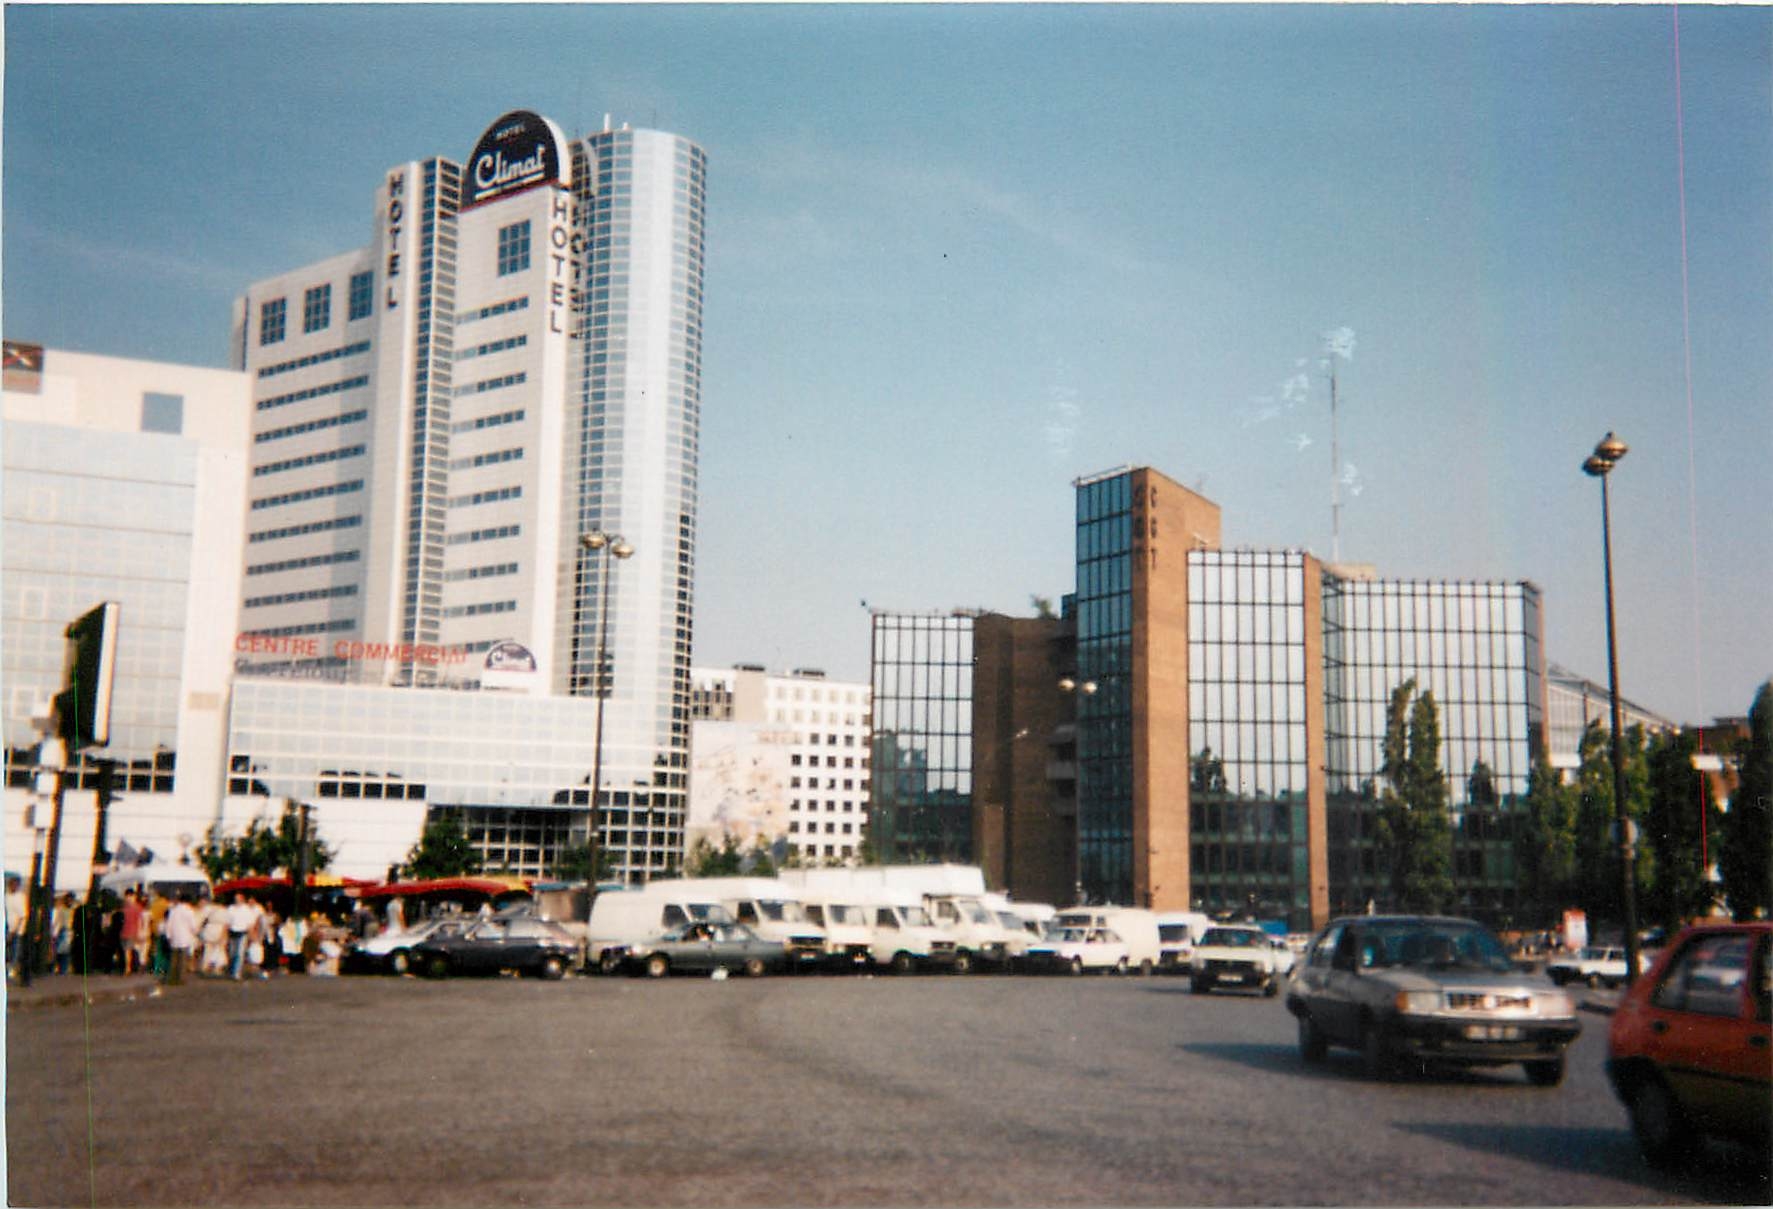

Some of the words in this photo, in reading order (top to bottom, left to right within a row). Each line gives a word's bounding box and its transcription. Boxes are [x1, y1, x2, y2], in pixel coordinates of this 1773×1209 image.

[476, 143, 545, 189] Climat
[387, 173, 403, 309] HOTEL
[550, 197, 567, 334] HOTEL
[235, 632, 320, 657] CENTRE
